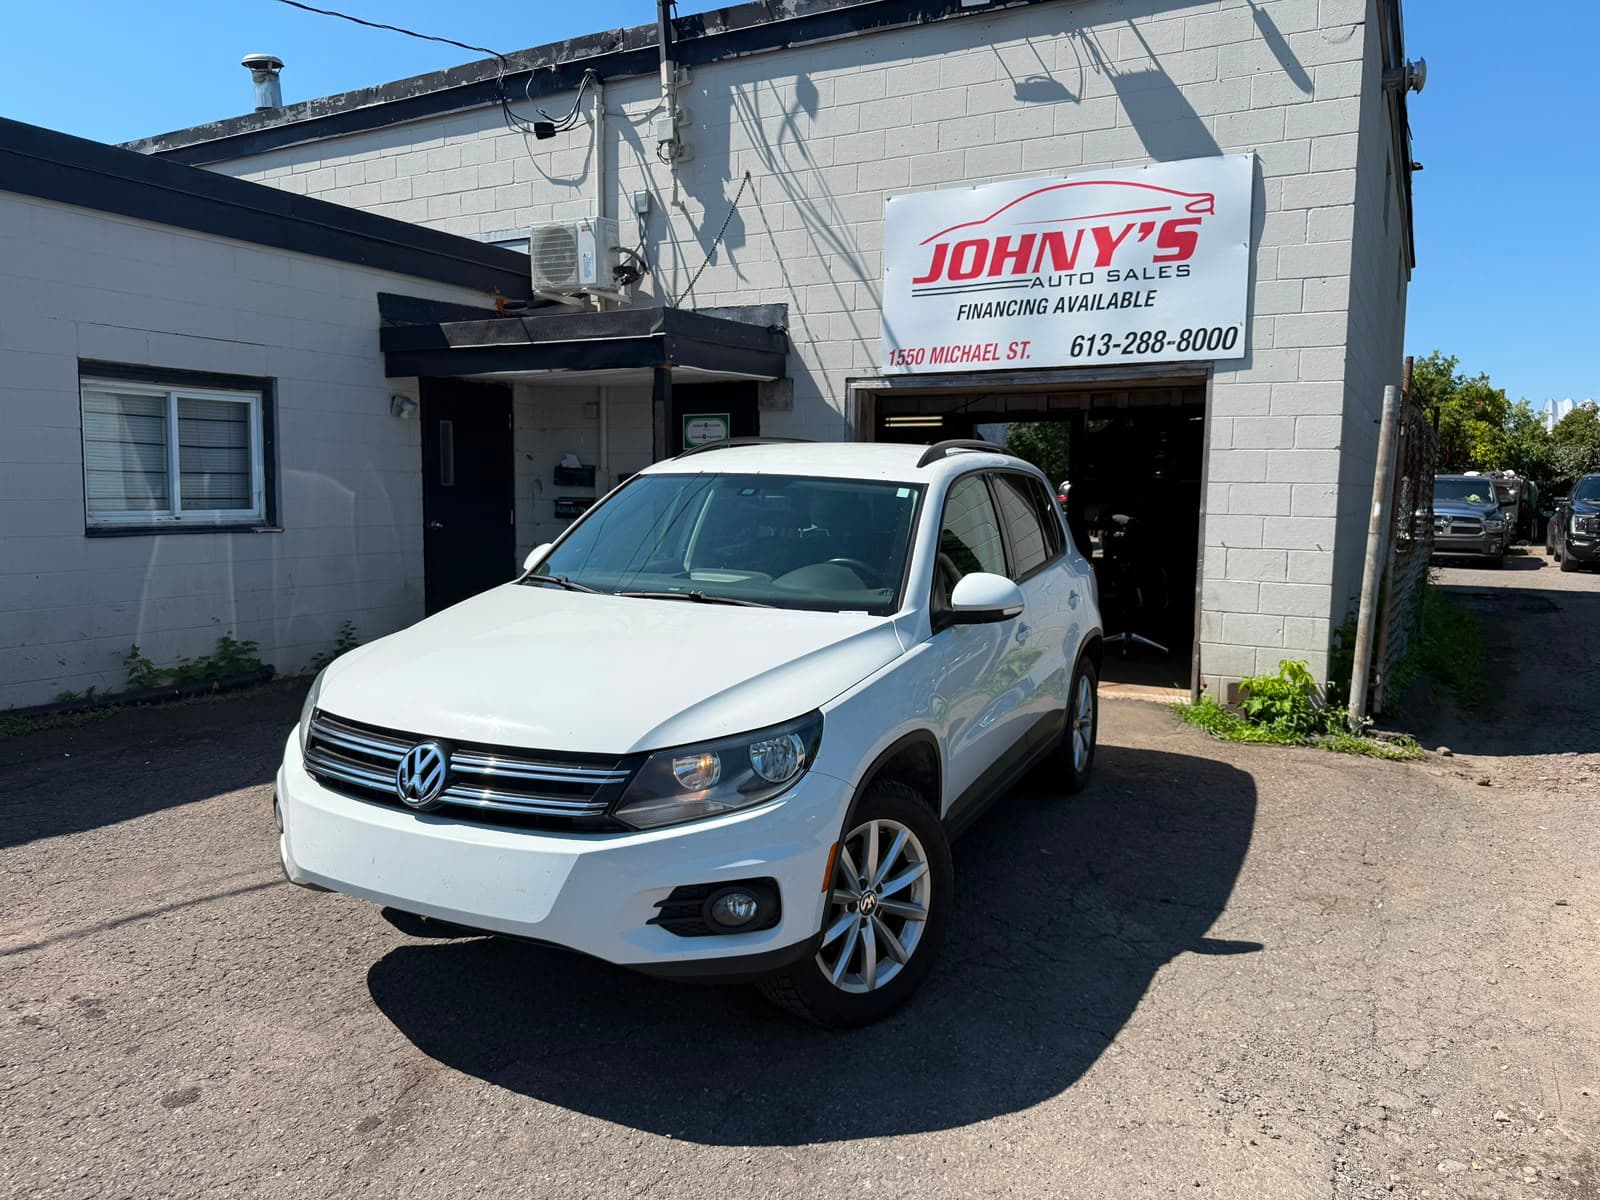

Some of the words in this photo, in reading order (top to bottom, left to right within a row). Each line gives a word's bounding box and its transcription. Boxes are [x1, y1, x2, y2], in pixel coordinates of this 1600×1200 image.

[912, 217, 1202, 285] JOHNY'S
[1030, 272, 1094, 289] AUTO
[1106, 264, 1191, 283] SALES
[957, 297, 1048, 321] FINANCING
[1053, 289, 1158, 314] AVAILABLE
[889, 347, 926, 367] 1550
[928, 343, 1001, 365] MICHAEL
[1006, 341, 1032, 360] ST.
[1069, 326, 1239, 358] 613-288-8000
